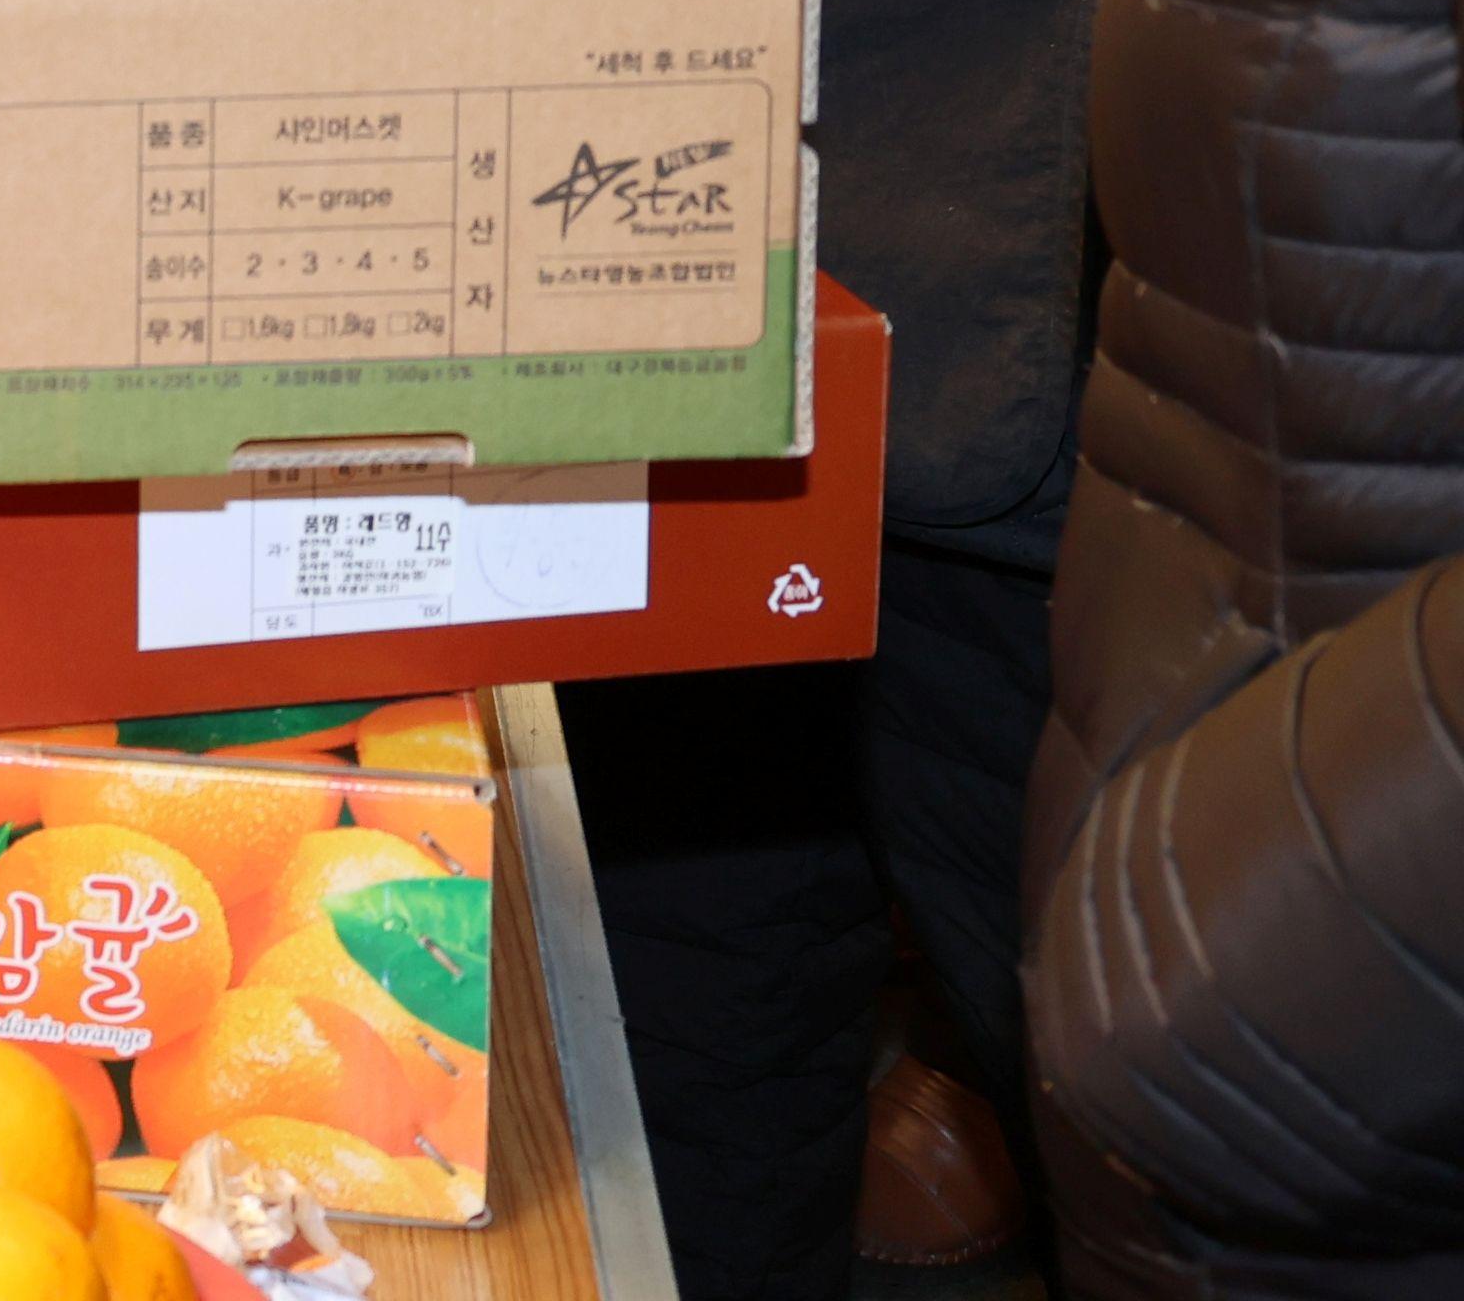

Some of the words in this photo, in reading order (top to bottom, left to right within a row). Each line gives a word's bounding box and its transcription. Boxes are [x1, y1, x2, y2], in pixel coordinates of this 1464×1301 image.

[654, 49, 675, 73] 후
[145, 254, 208, 283] 송이수
[68, 1024, 150, 1053] orange
